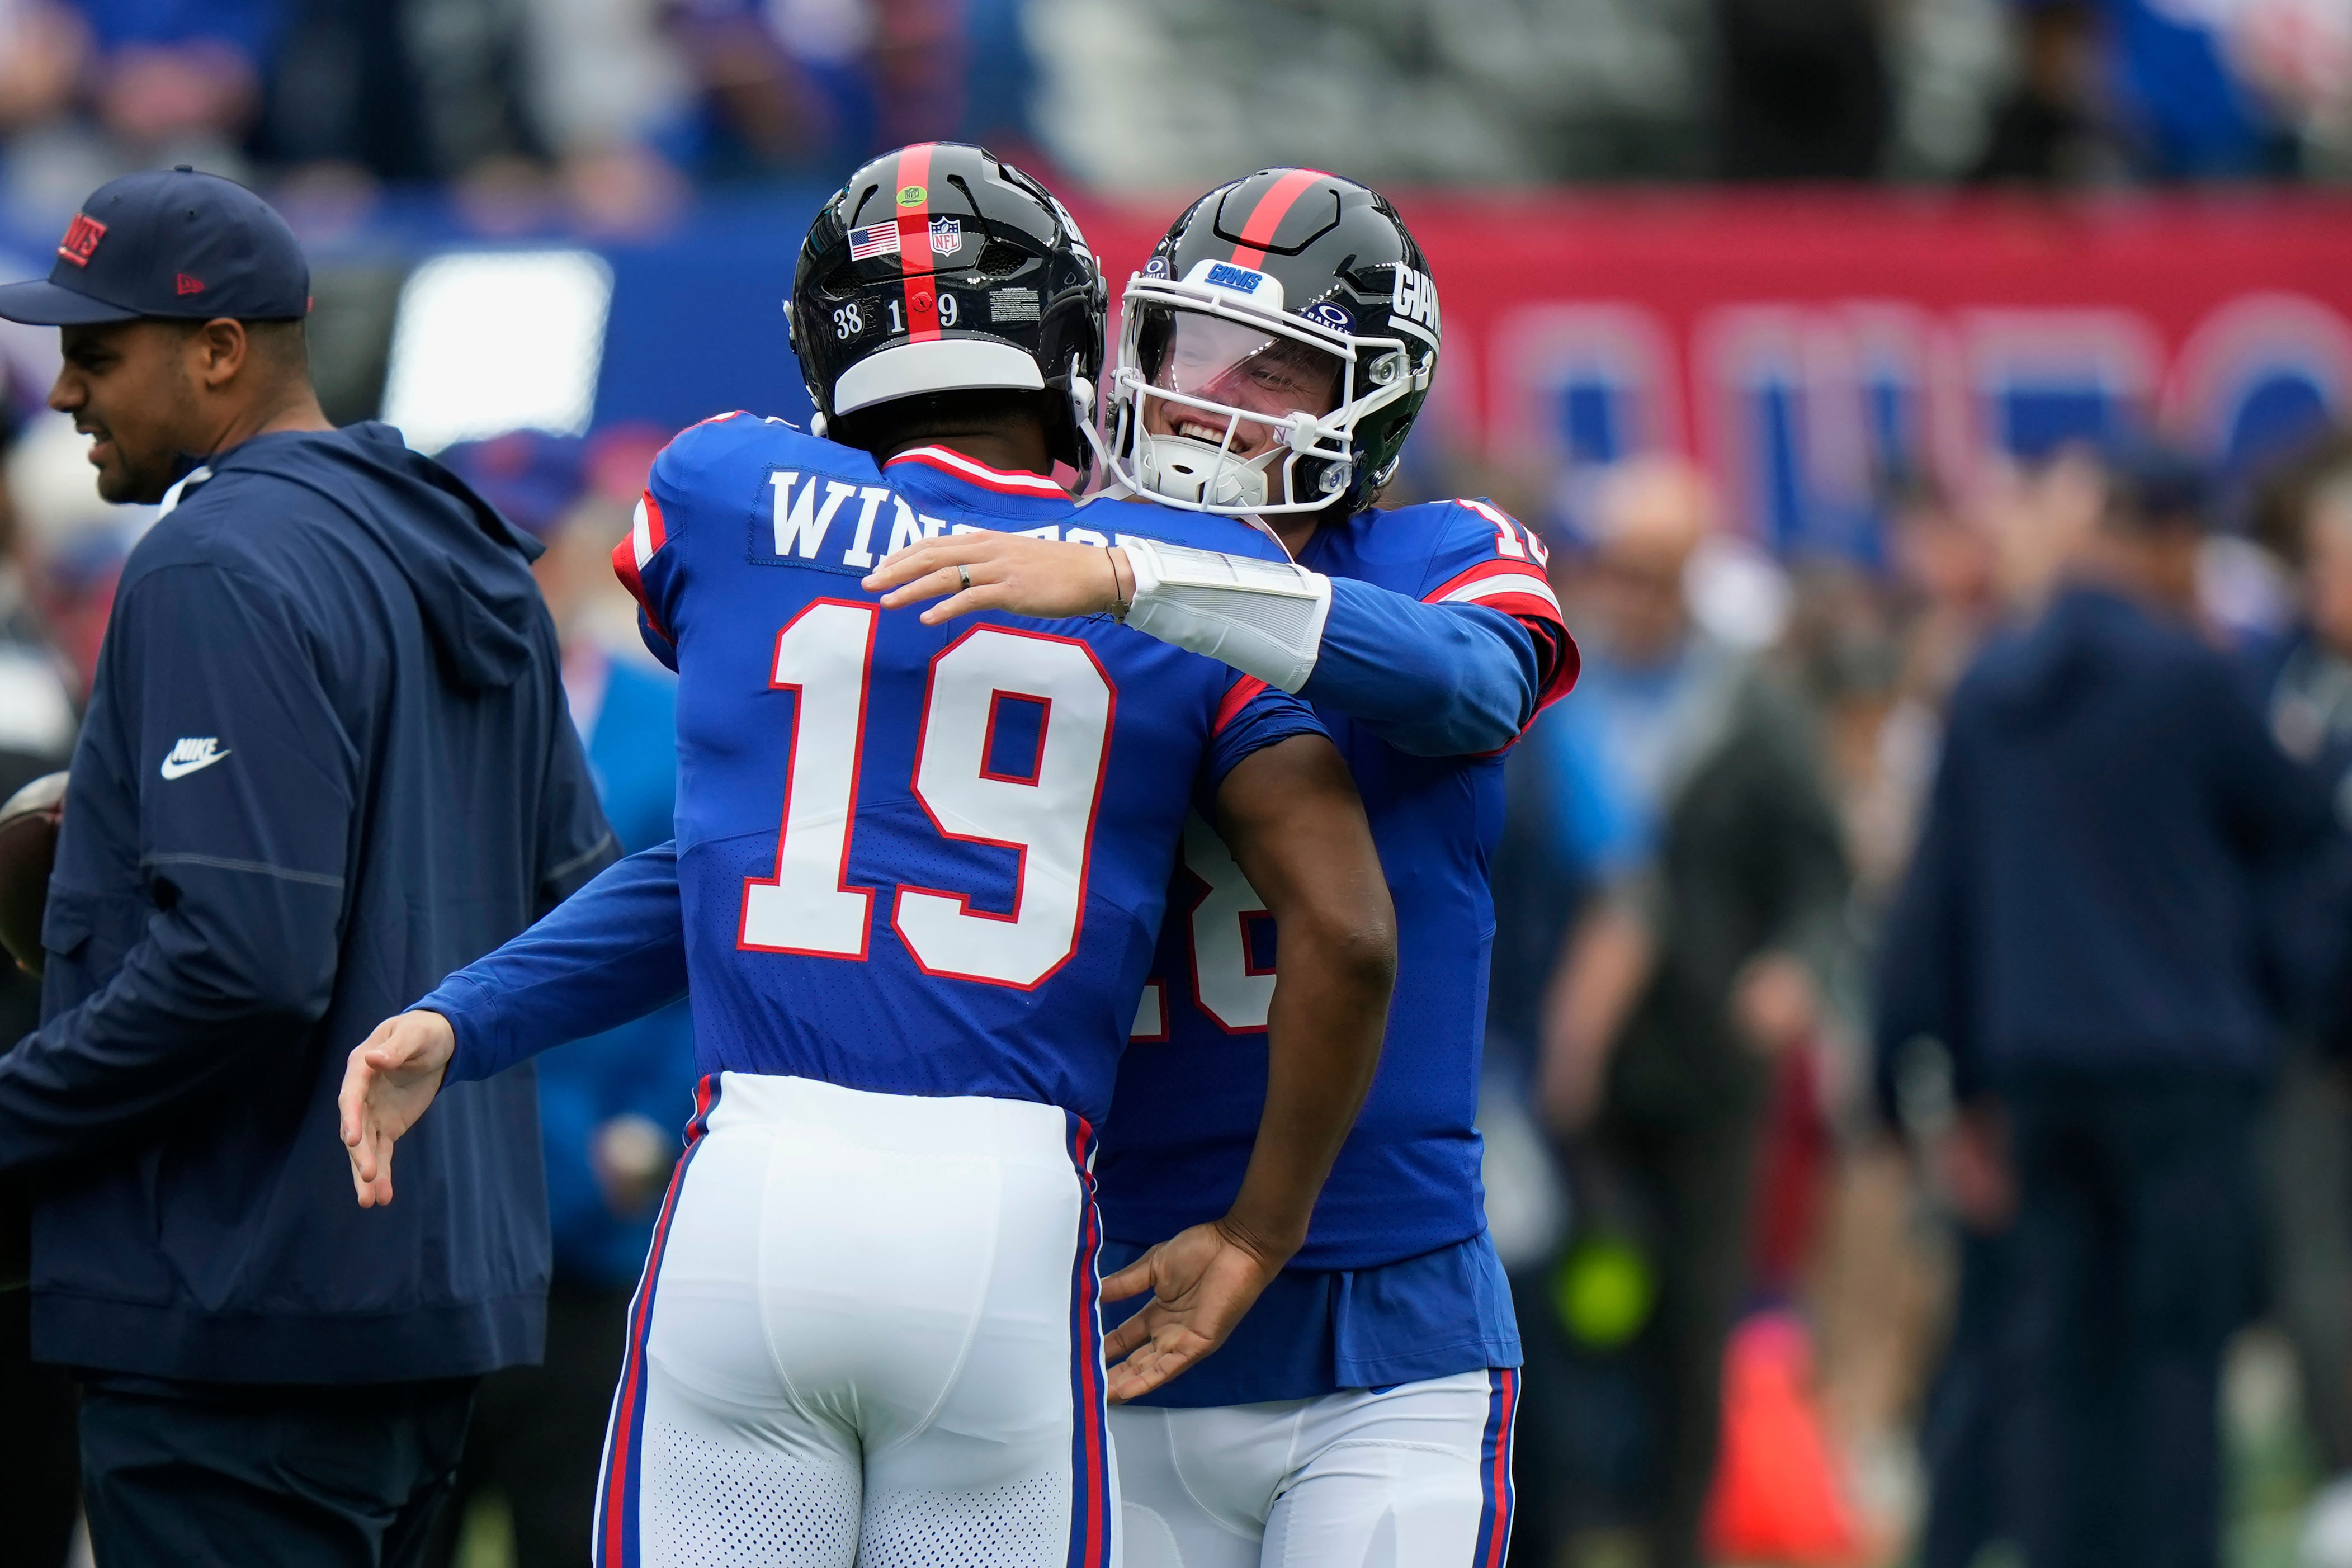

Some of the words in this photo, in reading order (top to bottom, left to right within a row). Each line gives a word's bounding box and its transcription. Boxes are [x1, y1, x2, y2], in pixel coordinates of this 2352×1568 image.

[934, 234, 957, 250] NFL
[1207, 263, 1262, 290] GIANTS
[834, 303, 862, 339] 38
[172, 738, 218, 761] NIKE
[736, 596, 1118, 991] 19
